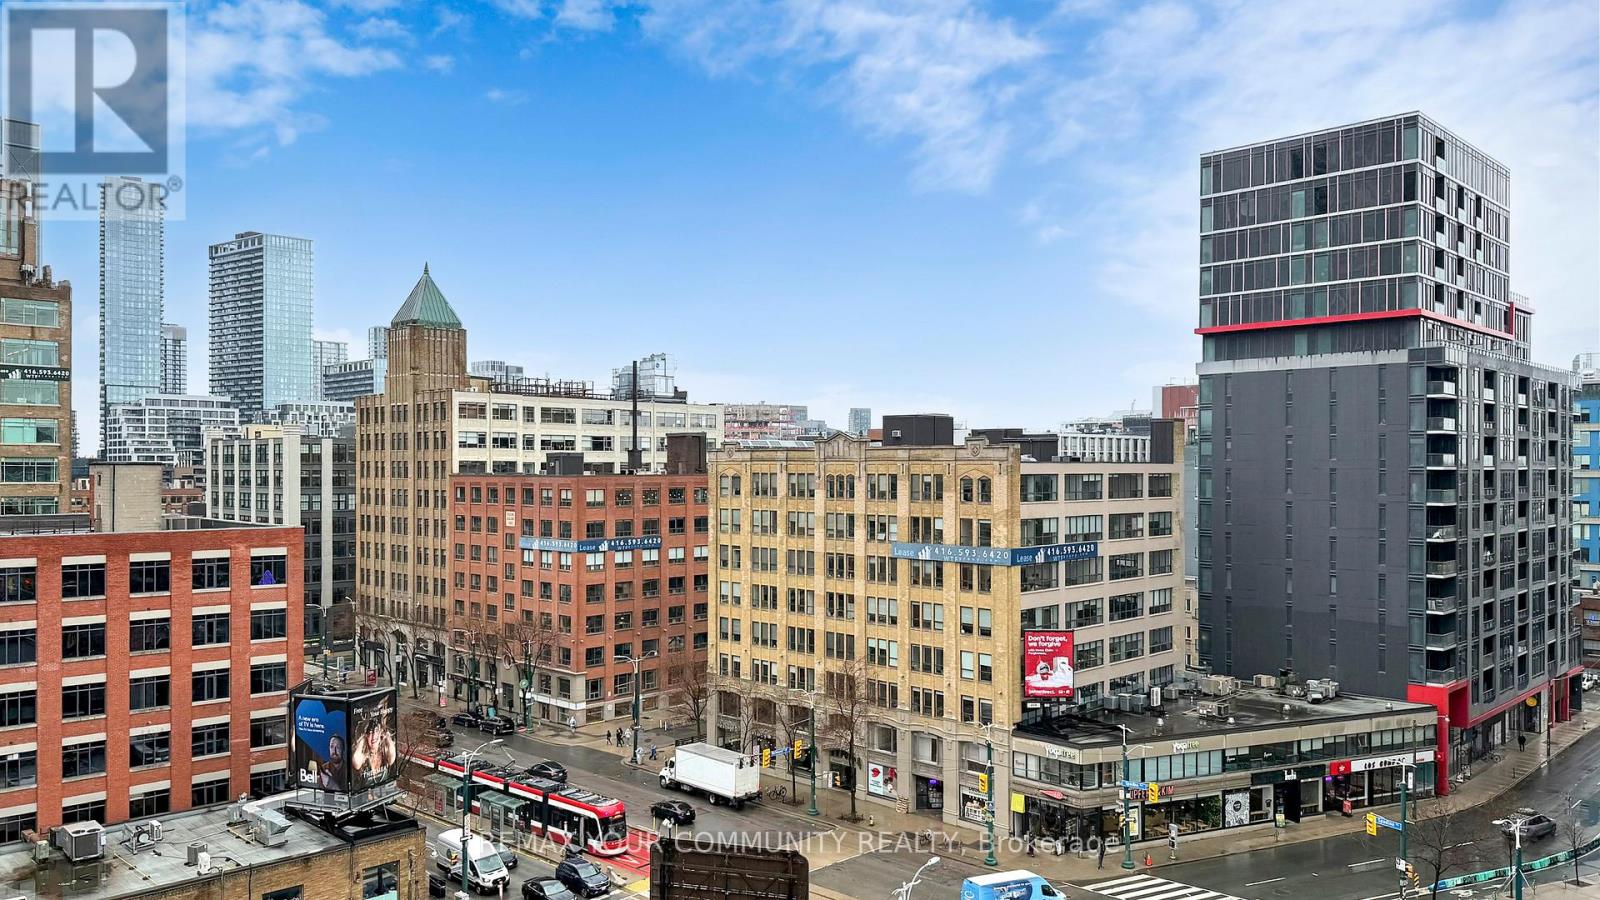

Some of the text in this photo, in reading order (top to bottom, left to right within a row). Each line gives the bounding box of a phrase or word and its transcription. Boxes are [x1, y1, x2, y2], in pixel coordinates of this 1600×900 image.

[611, 537, 661, 546] 416.593.6420
[894, 546, 1009, 559] Lease 416.593.6420
[1016, 544, 1095, 563] Lease 416.593.6420
[300, 768, 318, 784] Bell
